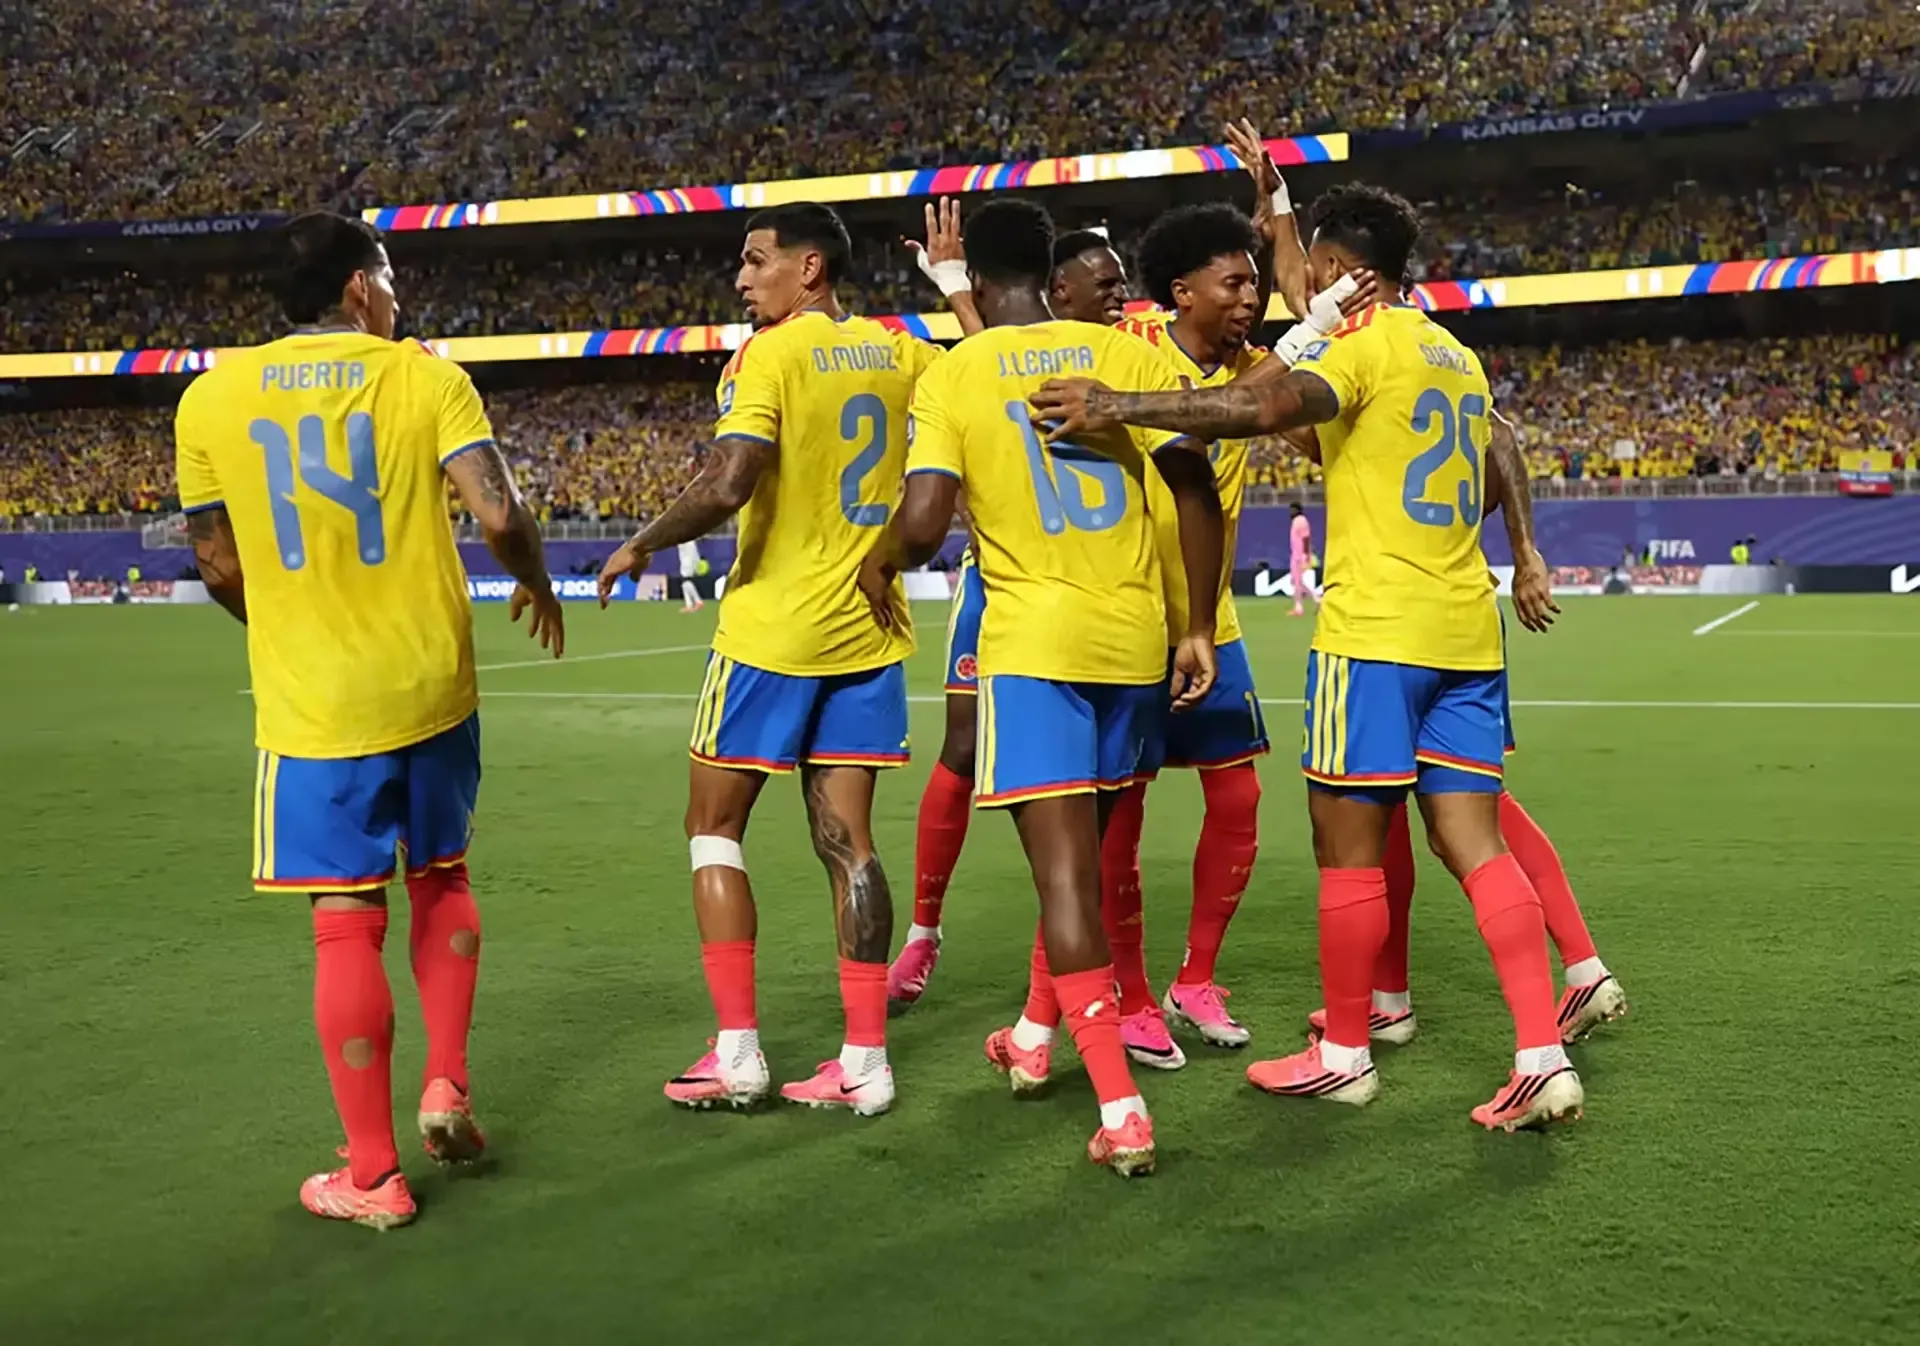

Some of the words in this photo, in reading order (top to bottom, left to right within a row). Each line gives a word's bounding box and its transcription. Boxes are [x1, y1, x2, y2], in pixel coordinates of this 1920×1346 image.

[1461, 115, 1576, 140] KANSAS
[1580, 110, 1645, 128] CITY
[121, 219, 209, 237] KANSAS
[261, 360, 365, 393] PUERTA
[248, 411, 386, 571] 14
[841, 393, 889, 527] 2
[1005, 400, 1127, 535] 16
[1402, 387, 1485, 528] 25
[1648, 539, 1696, 559] FIFA
